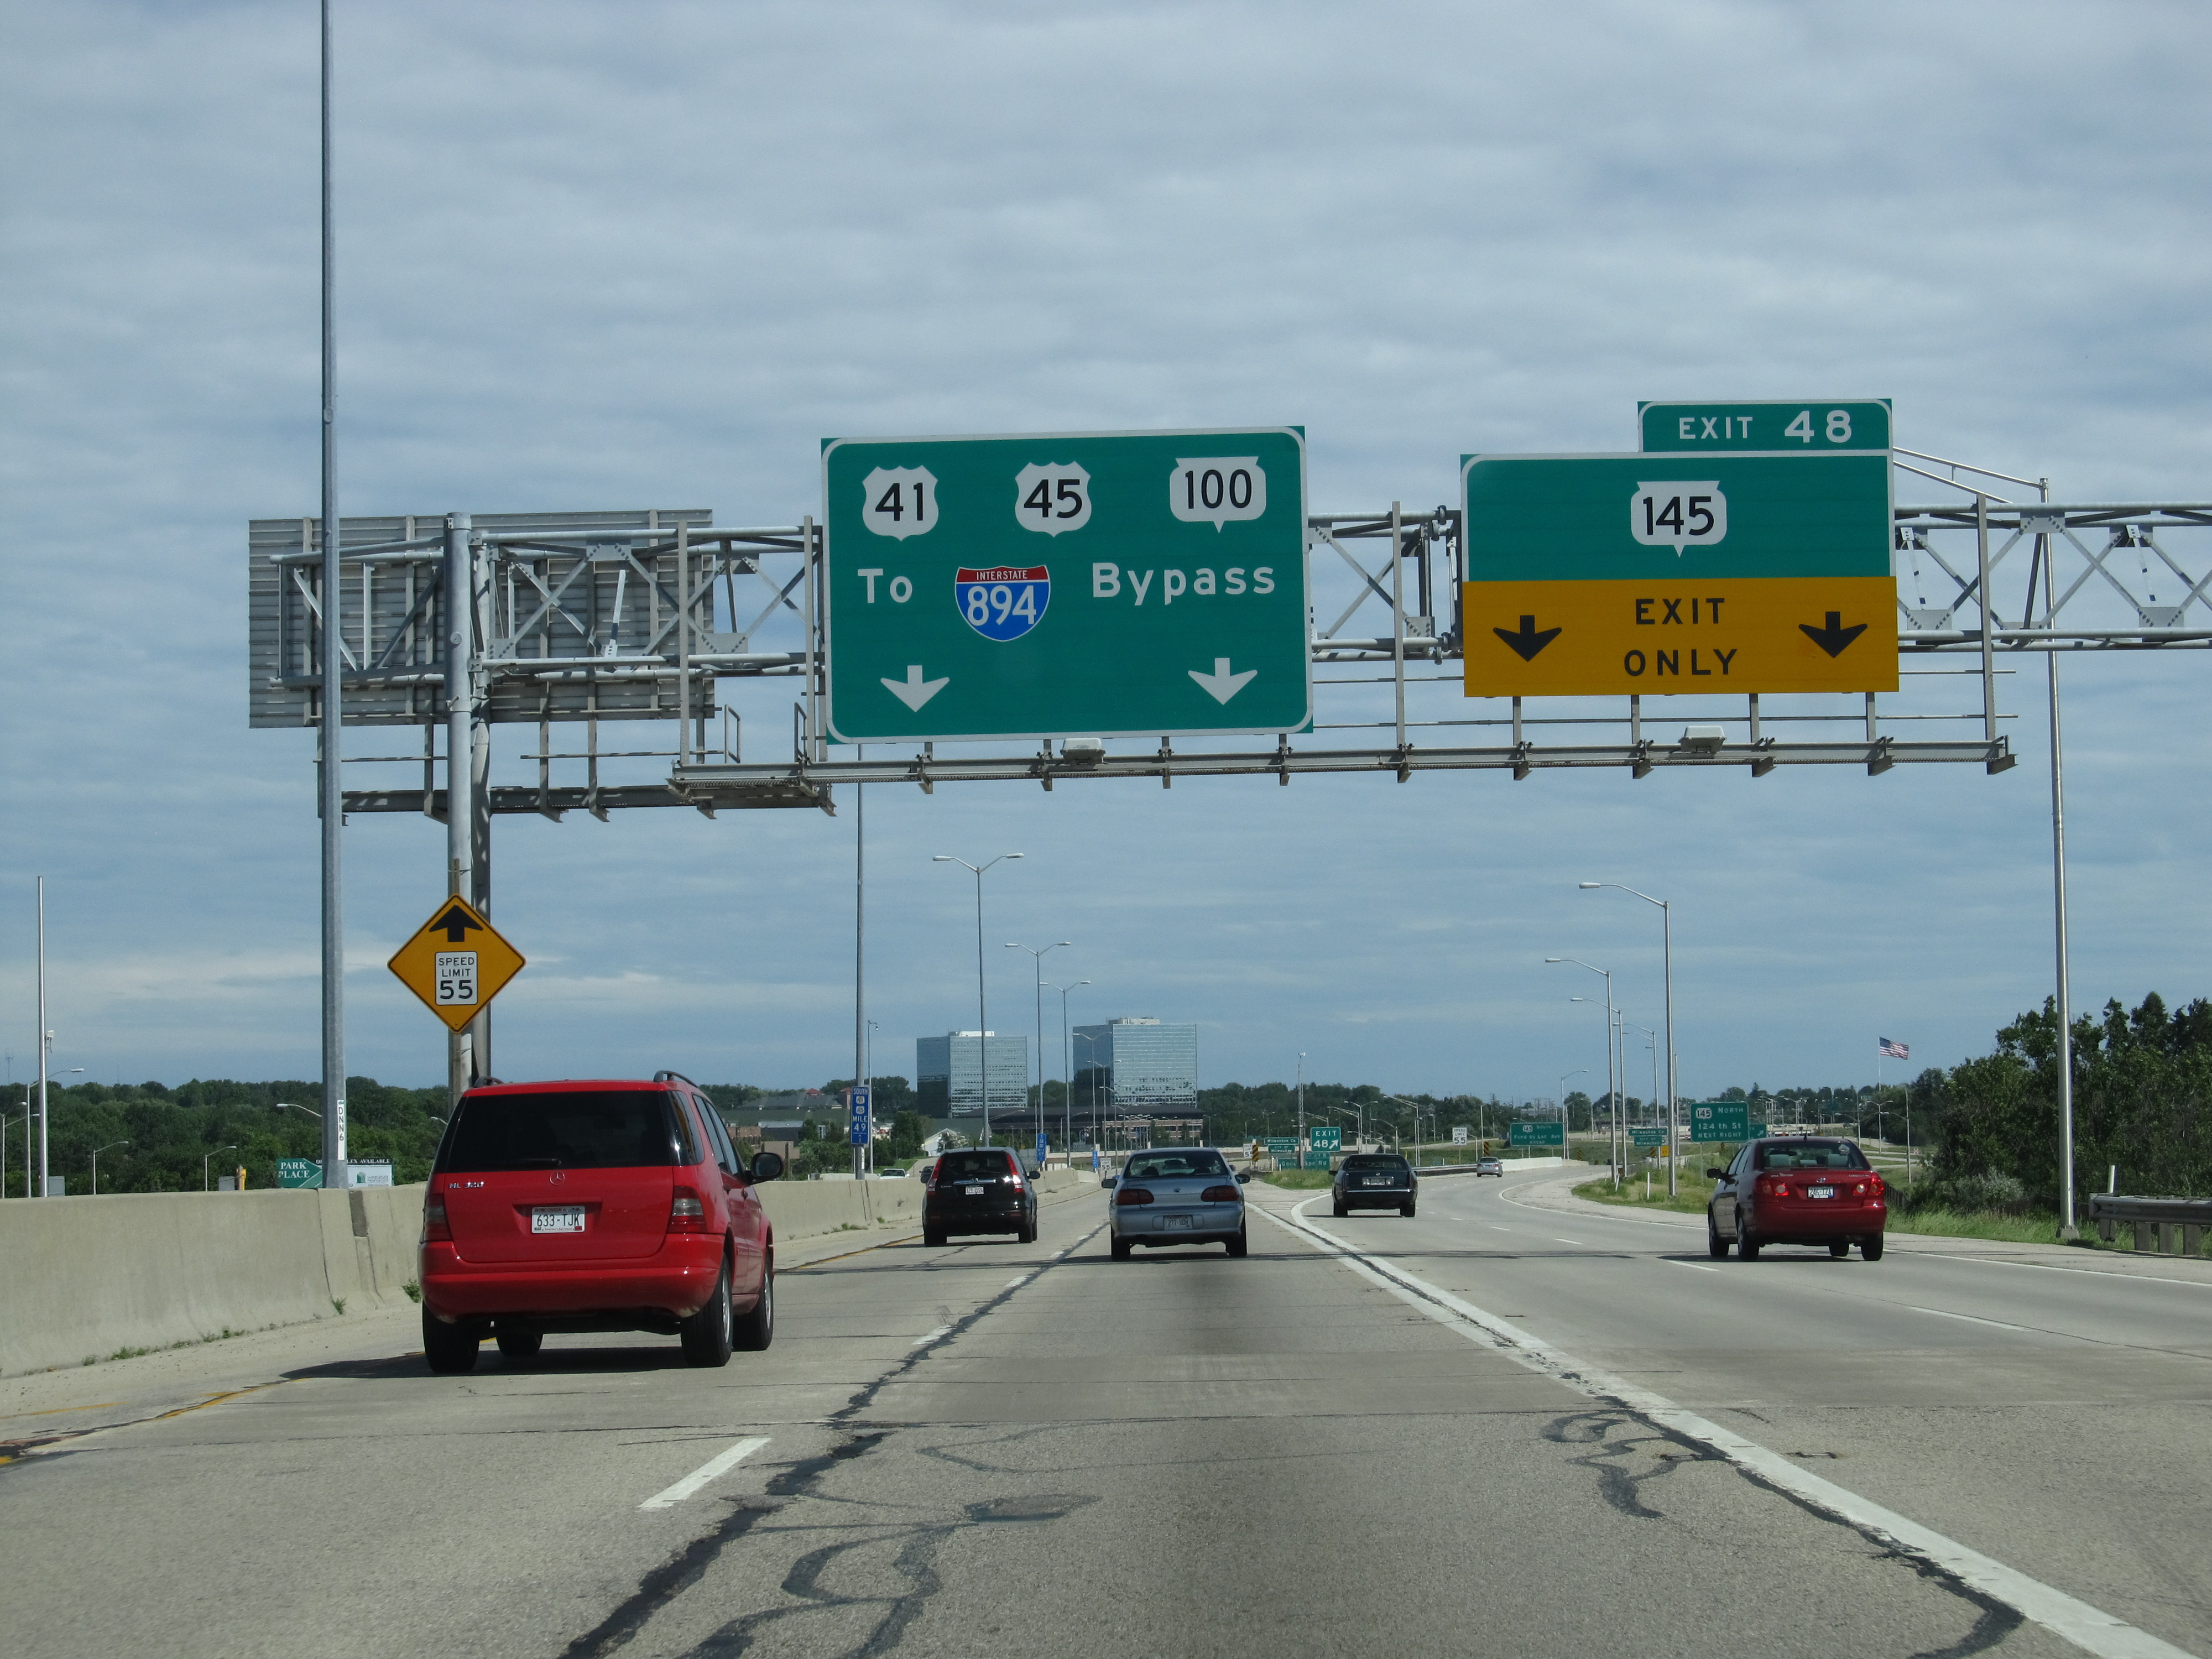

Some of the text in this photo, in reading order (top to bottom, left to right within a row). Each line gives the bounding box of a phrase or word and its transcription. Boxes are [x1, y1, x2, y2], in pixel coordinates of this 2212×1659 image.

[1679, 410, 1852, 444] EXIT 48
[874, 482, 926, 522] 41
[1023, 478, 1084, 519] 45
[1184, 468, 1253, 510] 100
[1642, 496, 1714, 536] 145
[857, 562, 1276, 606] To Bypass
[975, 570, 1028, 581] INTERSTATE
[967, 584, 1037, 627] 894
[1635, 598, 1725, 625] EXIT
[1624, 649, 1738, 676] ONLY
[438, 957, 474, 966] SPEED
[441, 968, 471, 977] LIMIT
[440, 979, 473, 1000] 55
[853, 1123, 866, 1131] 49
[1313, 1139, 1328, 1148] 48
[280, 1161, 307, 1170] PARK
[537, 1213, 580, 1227] 633-TJK
